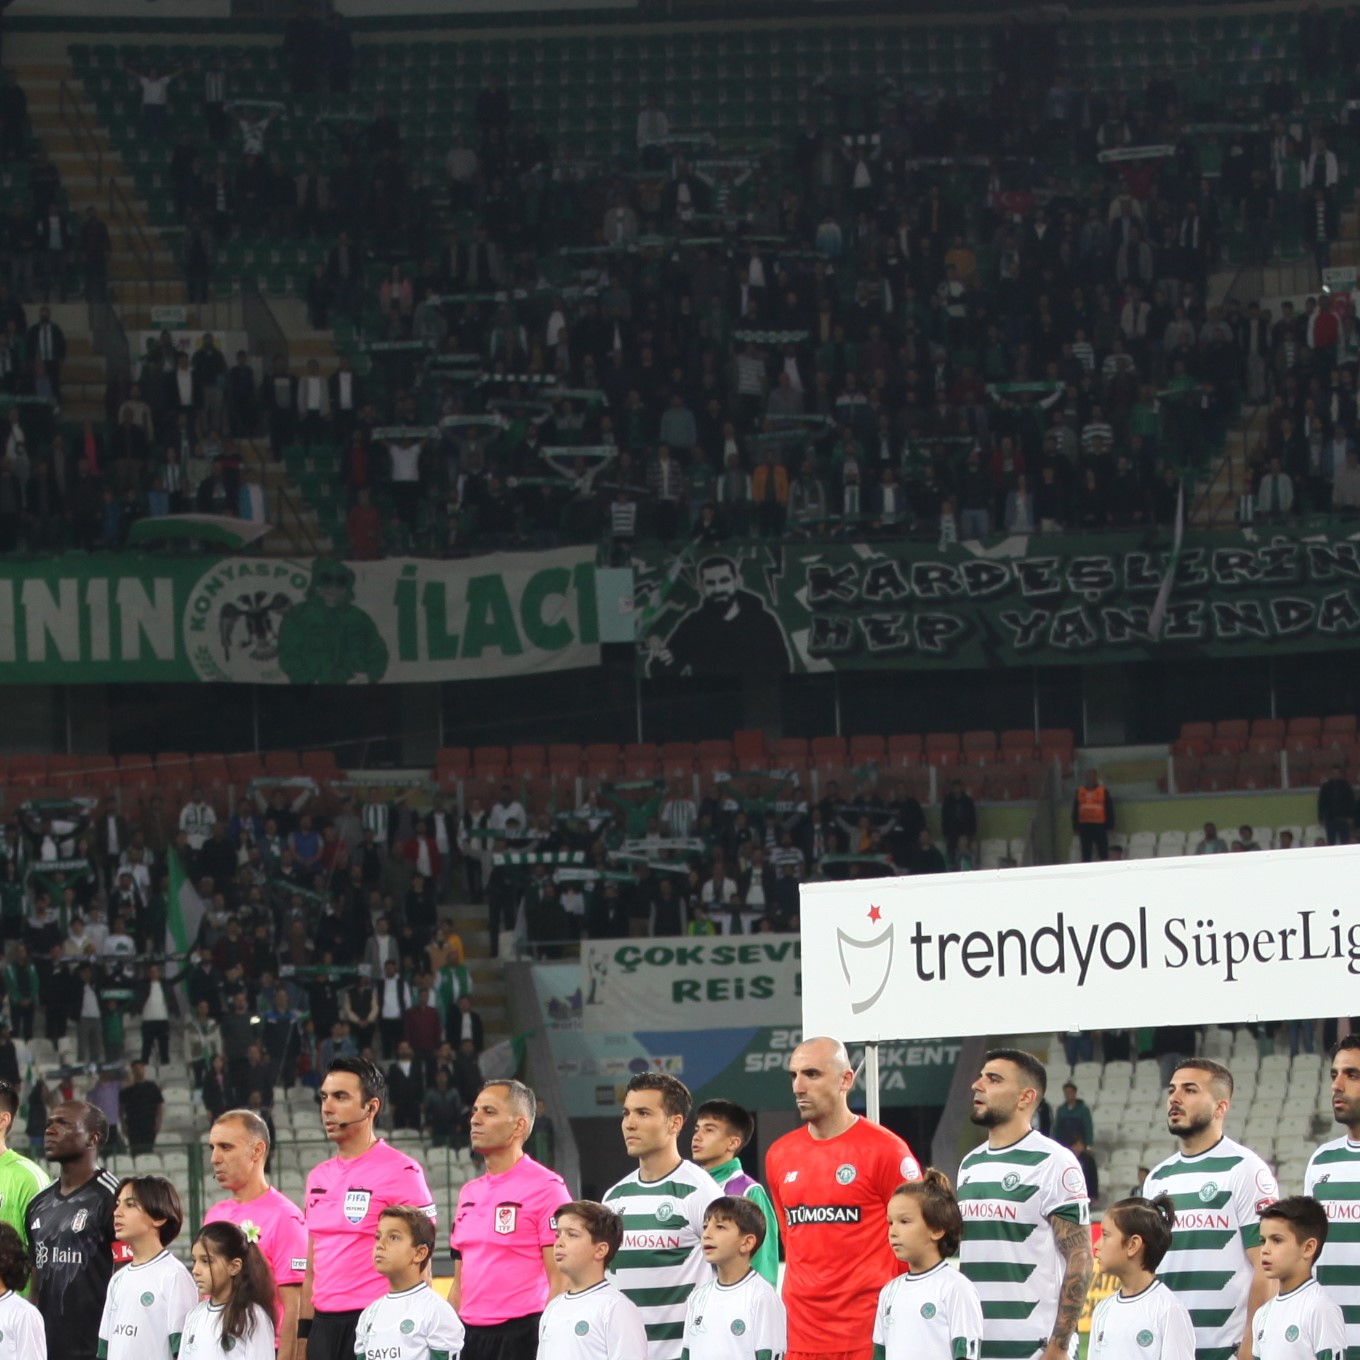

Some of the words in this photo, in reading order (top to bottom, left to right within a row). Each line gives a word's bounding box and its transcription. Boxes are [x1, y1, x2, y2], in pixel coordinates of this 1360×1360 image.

[811, 608, 963, 655] HEP
[911, 906, 1147, 987] trendyol
[614, 945, 704, 974] ÇOK
[347, 1194, 367, 1203] FIFA
[791, 1206, 859, 1223] TÜMOSAN
[1170, 1211, 1230, 1229] MOSAN
[52, 1248, 82, 1264] Rain
